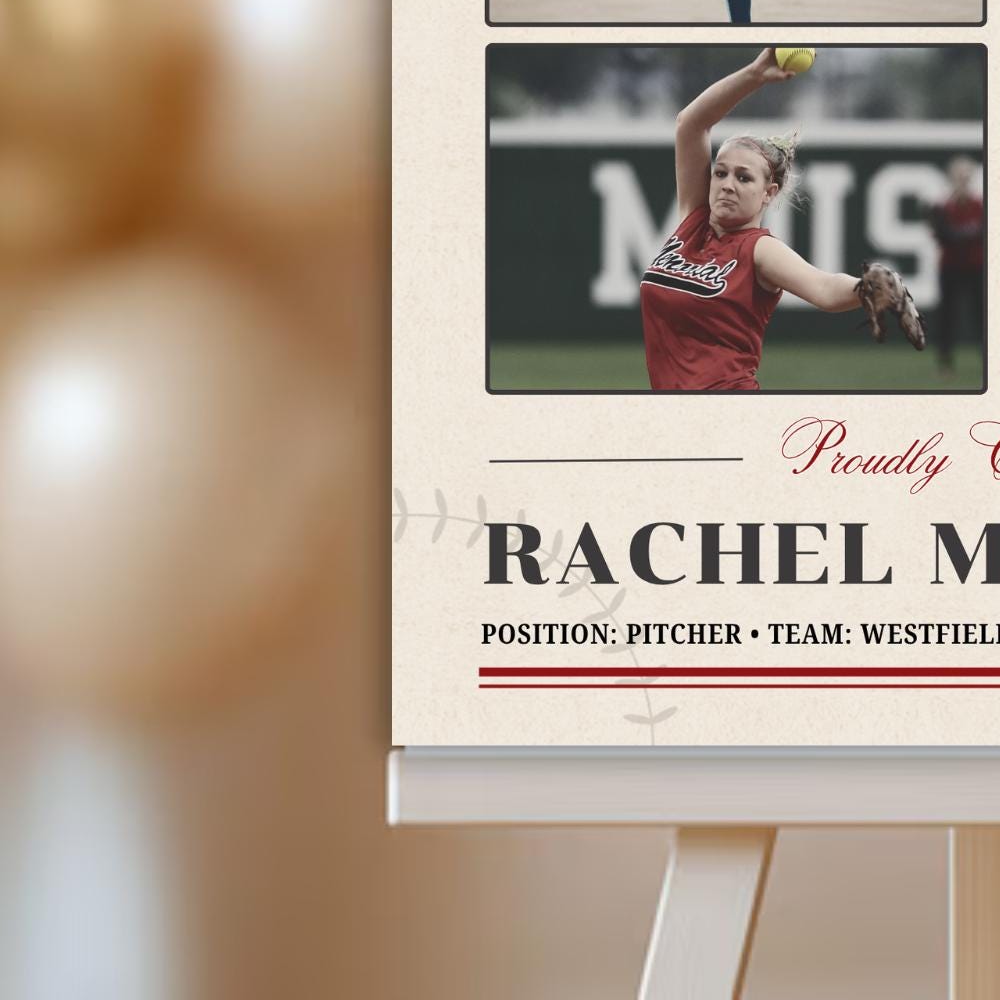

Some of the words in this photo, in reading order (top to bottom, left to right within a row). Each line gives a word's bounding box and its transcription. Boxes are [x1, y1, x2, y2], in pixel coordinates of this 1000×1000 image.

[781, 416, 952, 495] Proudly
[484, 521, 893, 586] RACHEL
[480, 622, 617, 645] POSITION:
[625, 622, 743, 645] PITCHER
[767, 622, 851, 645] TEAM:
